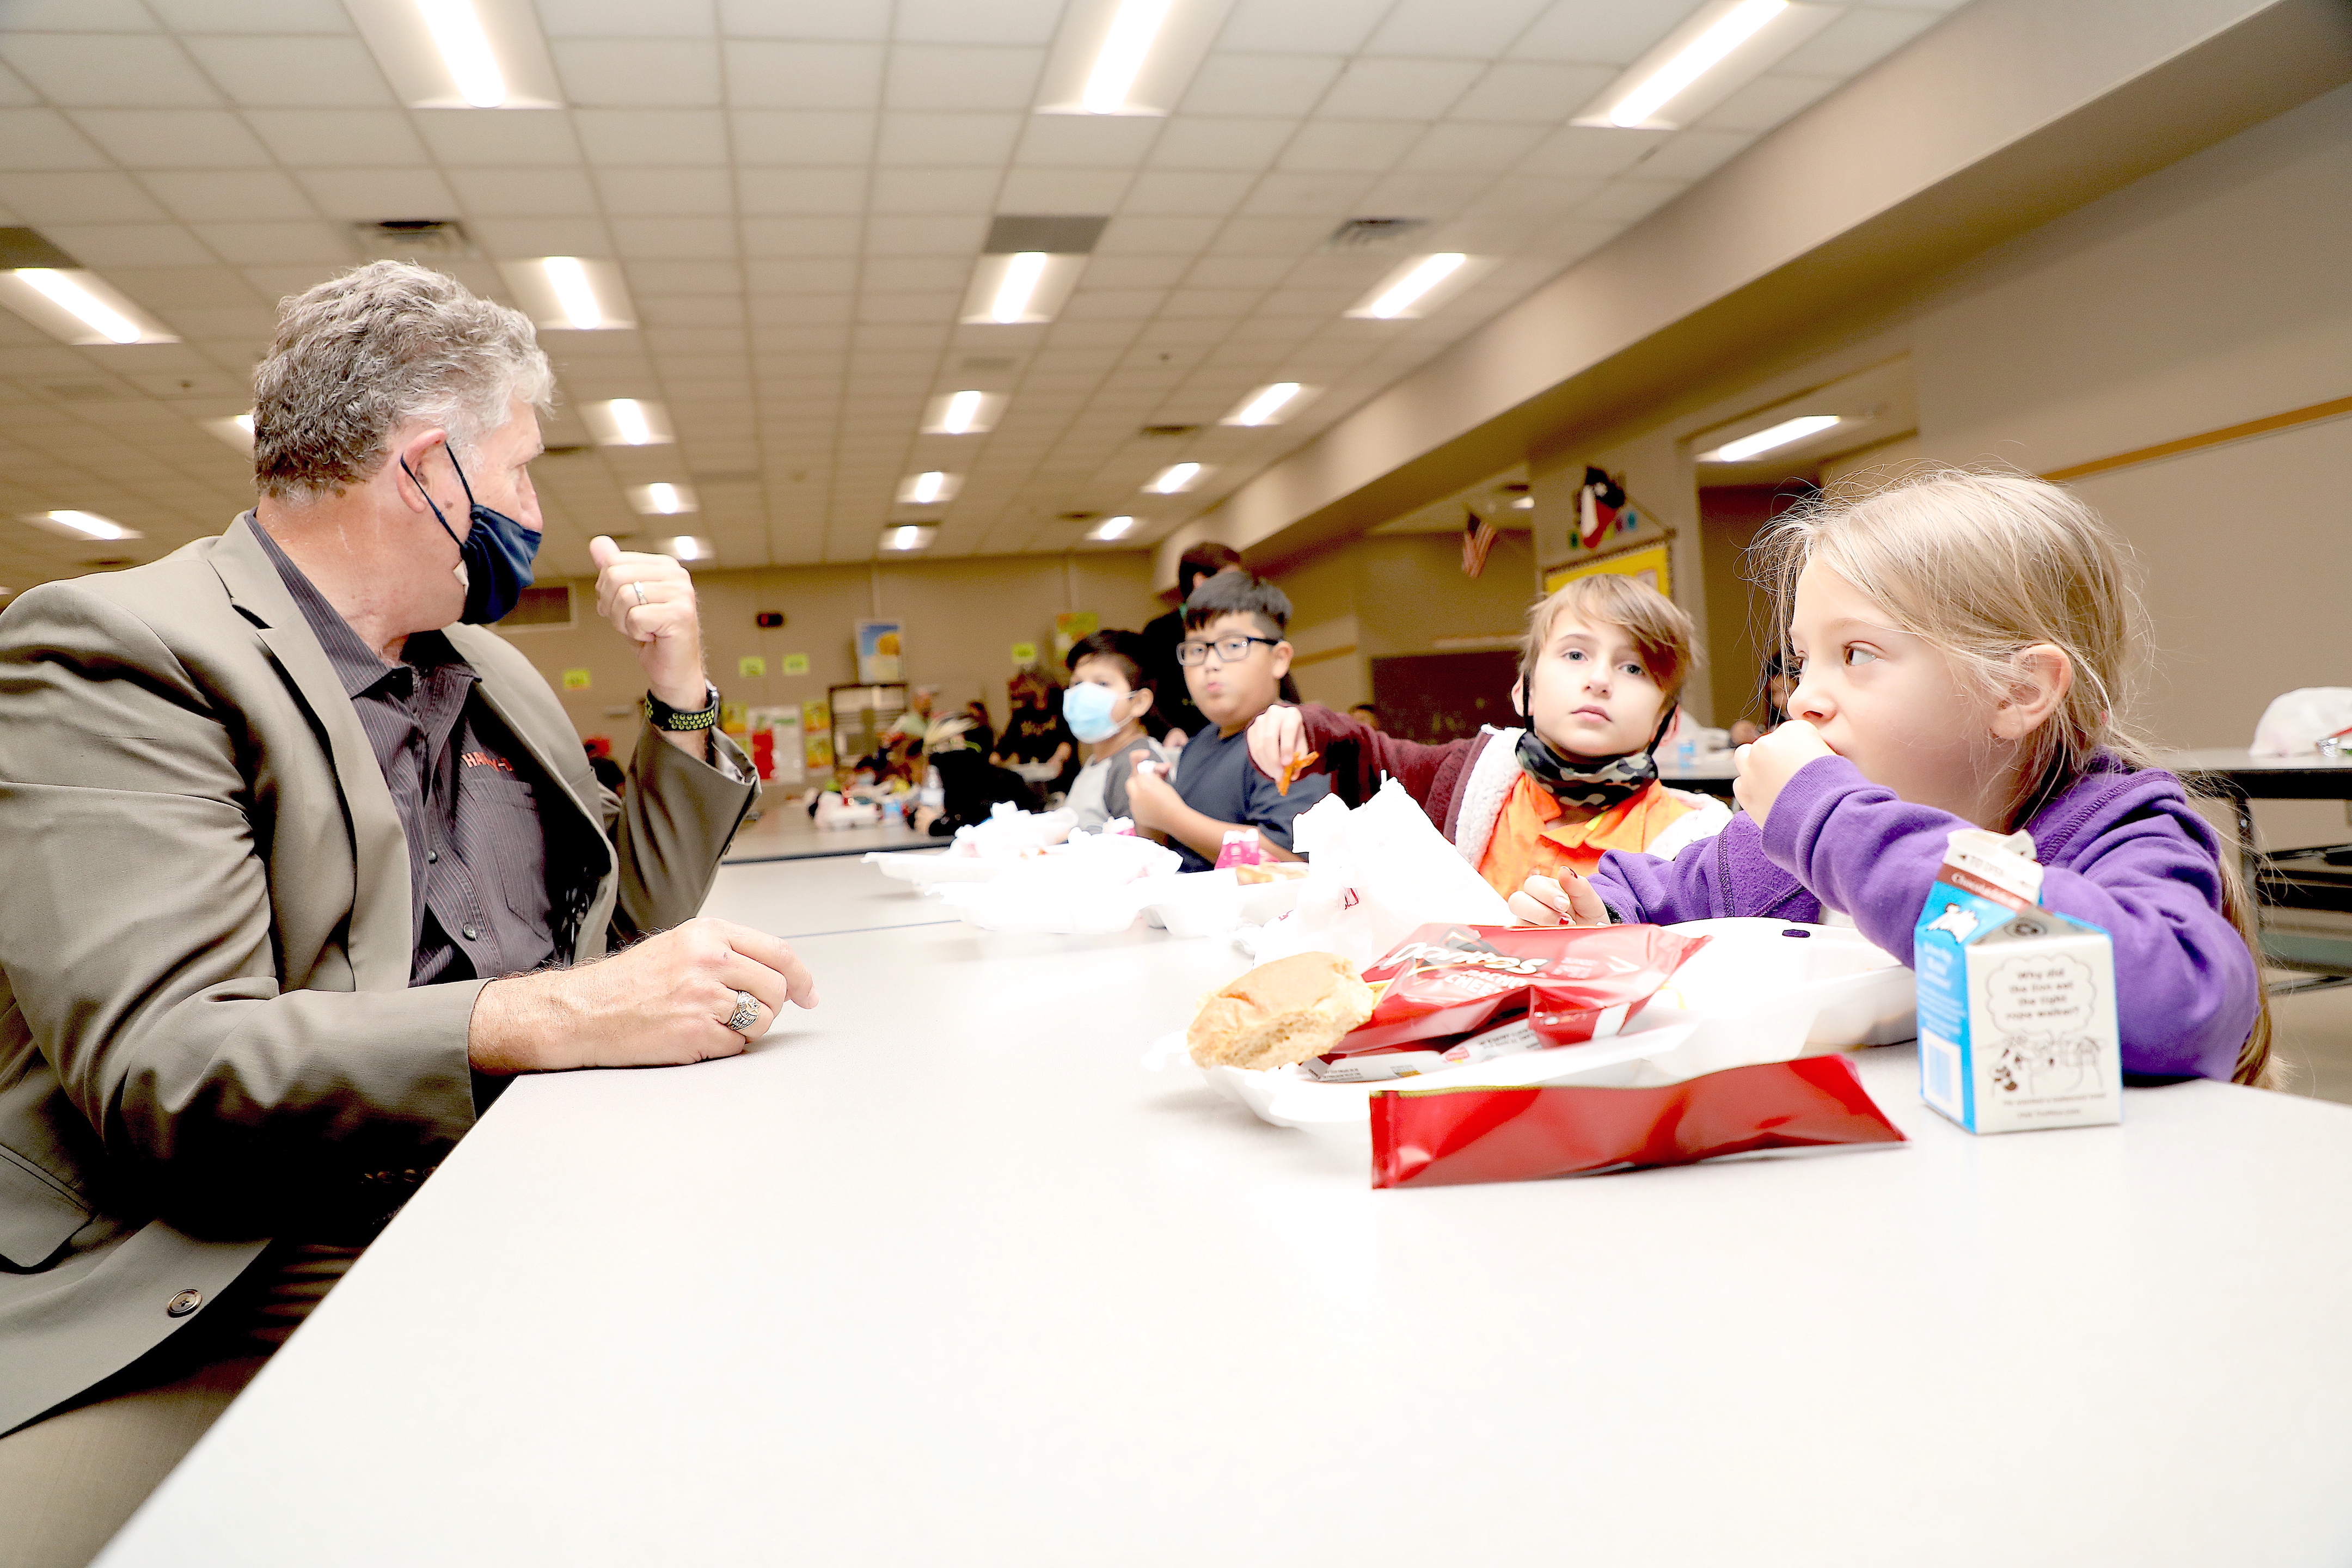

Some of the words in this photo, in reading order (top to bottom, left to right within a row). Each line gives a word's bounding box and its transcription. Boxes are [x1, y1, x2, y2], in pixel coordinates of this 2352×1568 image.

[2018, 970, 2042, 980] Why
[2047, 967, 2065, 977] did
[2008, 984, 2027, 994] the
[2056, 981, 2074, 990] eat
[2018, 997, 2036, 1006] the
